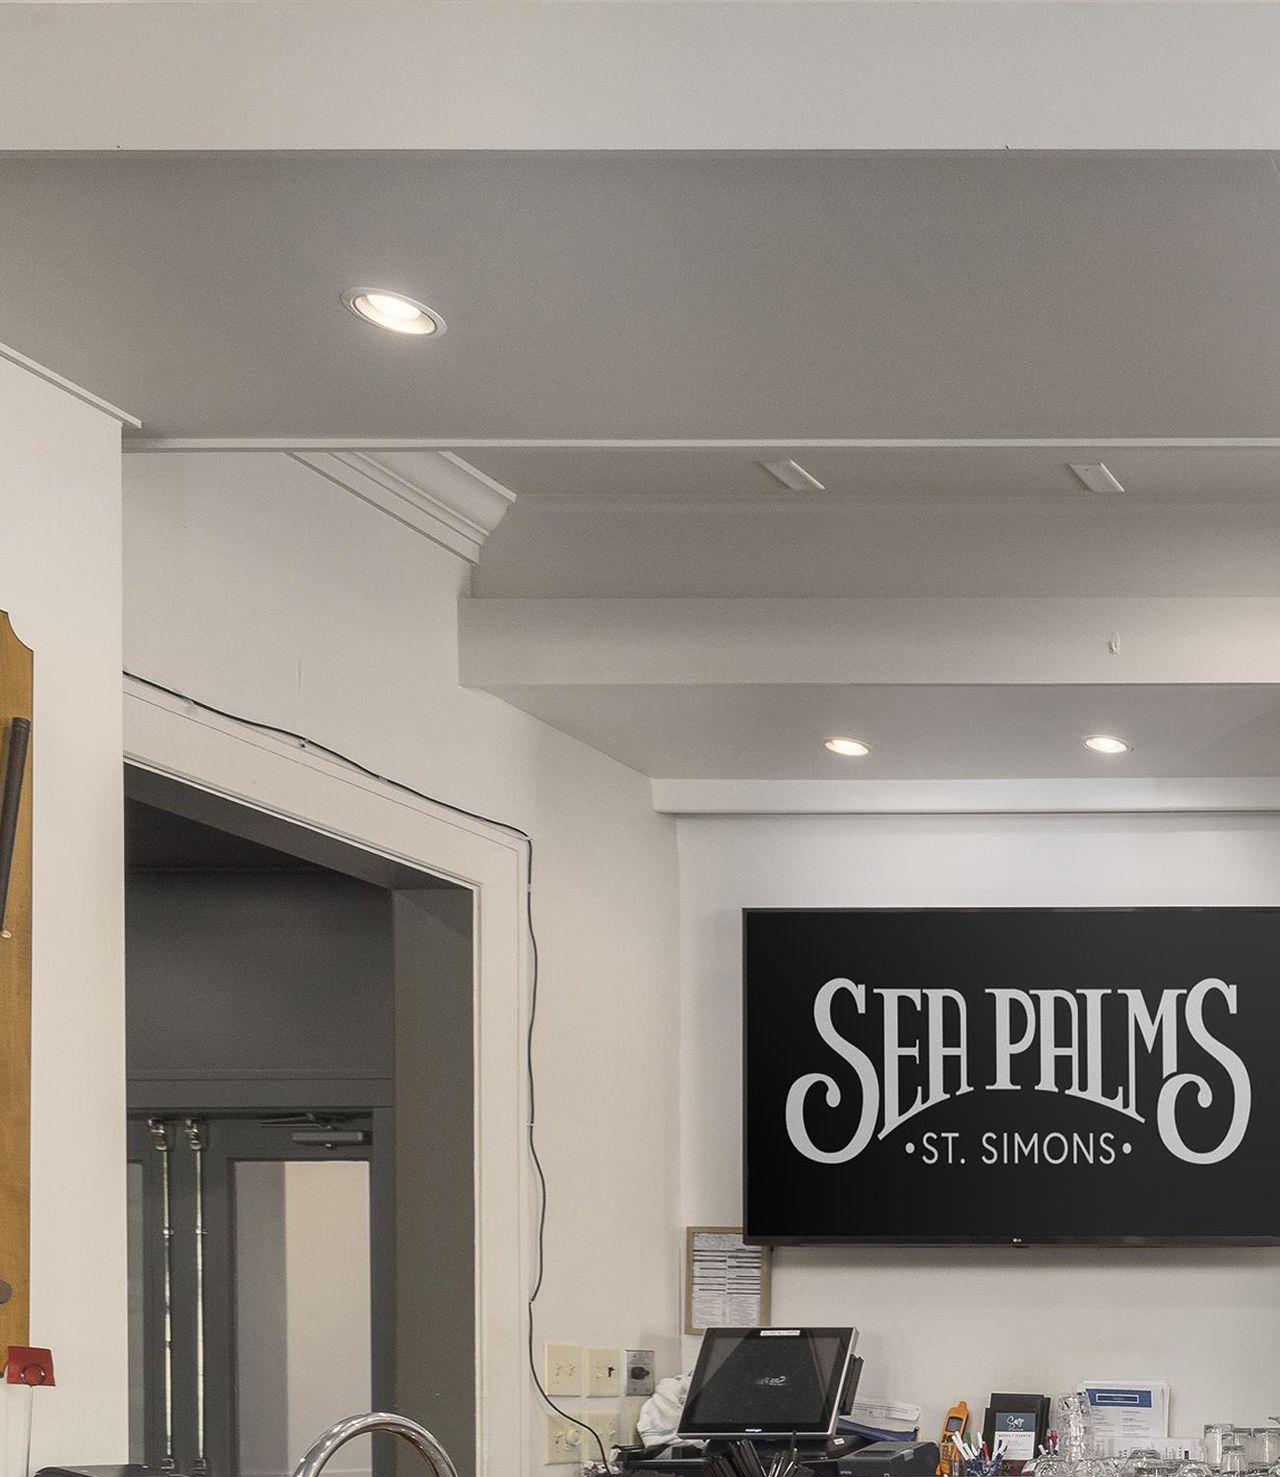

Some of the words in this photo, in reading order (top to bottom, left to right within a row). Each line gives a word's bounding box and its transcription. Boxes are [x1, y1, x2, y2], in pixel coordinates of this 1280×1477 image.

[785, 977, 974, 1165] SEA
[985, 977, 1252, 1165] PALMS
[921, 1132, 966, 1164] ST.
[981, 1132, 1116, 1164] SIMONS
